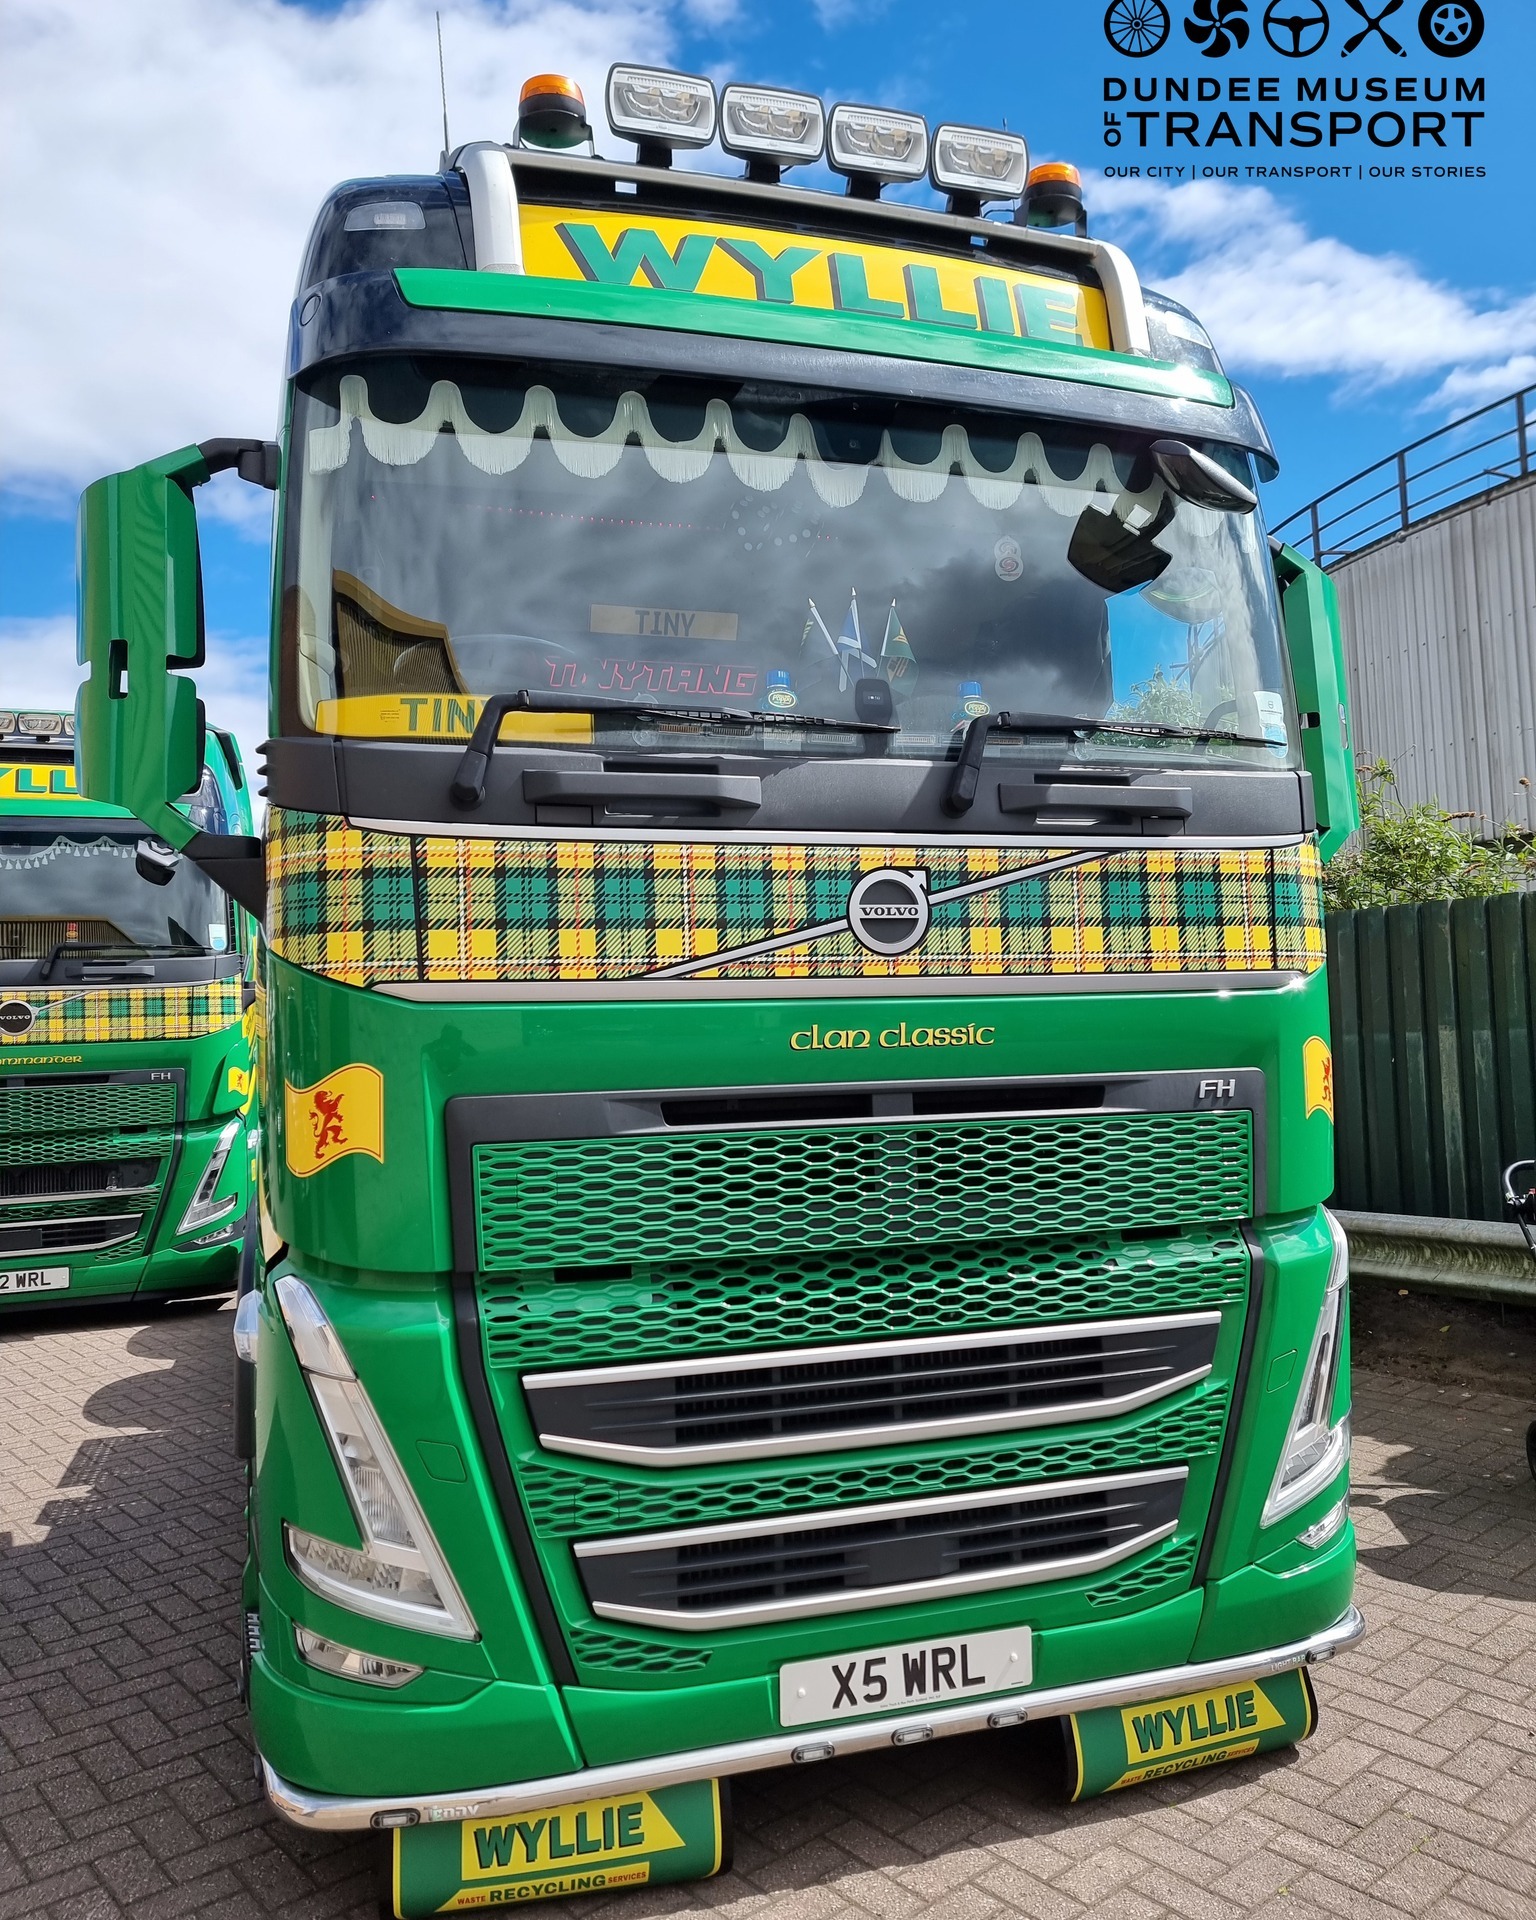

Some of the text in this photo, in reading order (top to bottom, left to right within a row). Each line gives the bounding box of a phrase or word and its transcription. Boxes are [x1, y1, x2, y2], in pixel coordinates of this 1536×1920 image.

[554, 222, 1083, 346] WYLLIE
[635, 610, 696, 637] TINY
[858, 906, 919, 917] VOLVO
[790, 1024, 870, 1051] clan
[151, 1072, 171, 1080] FH
[1199, 1079, 1236, 1099] FH
[16, 1272, 51, 1288] WRL
[832, 1644, 985, 1709] X5 WRL
[1131, 1690, 1257, 1754] WYLLIE
[1121, 1746, 1255, 1785] WASTE RECYCLING SERVICES
[473, 1802, 645, 1869] WYLLIE
[457, 1871, 647, 1906] WASTE RECYCLING SERVICES
